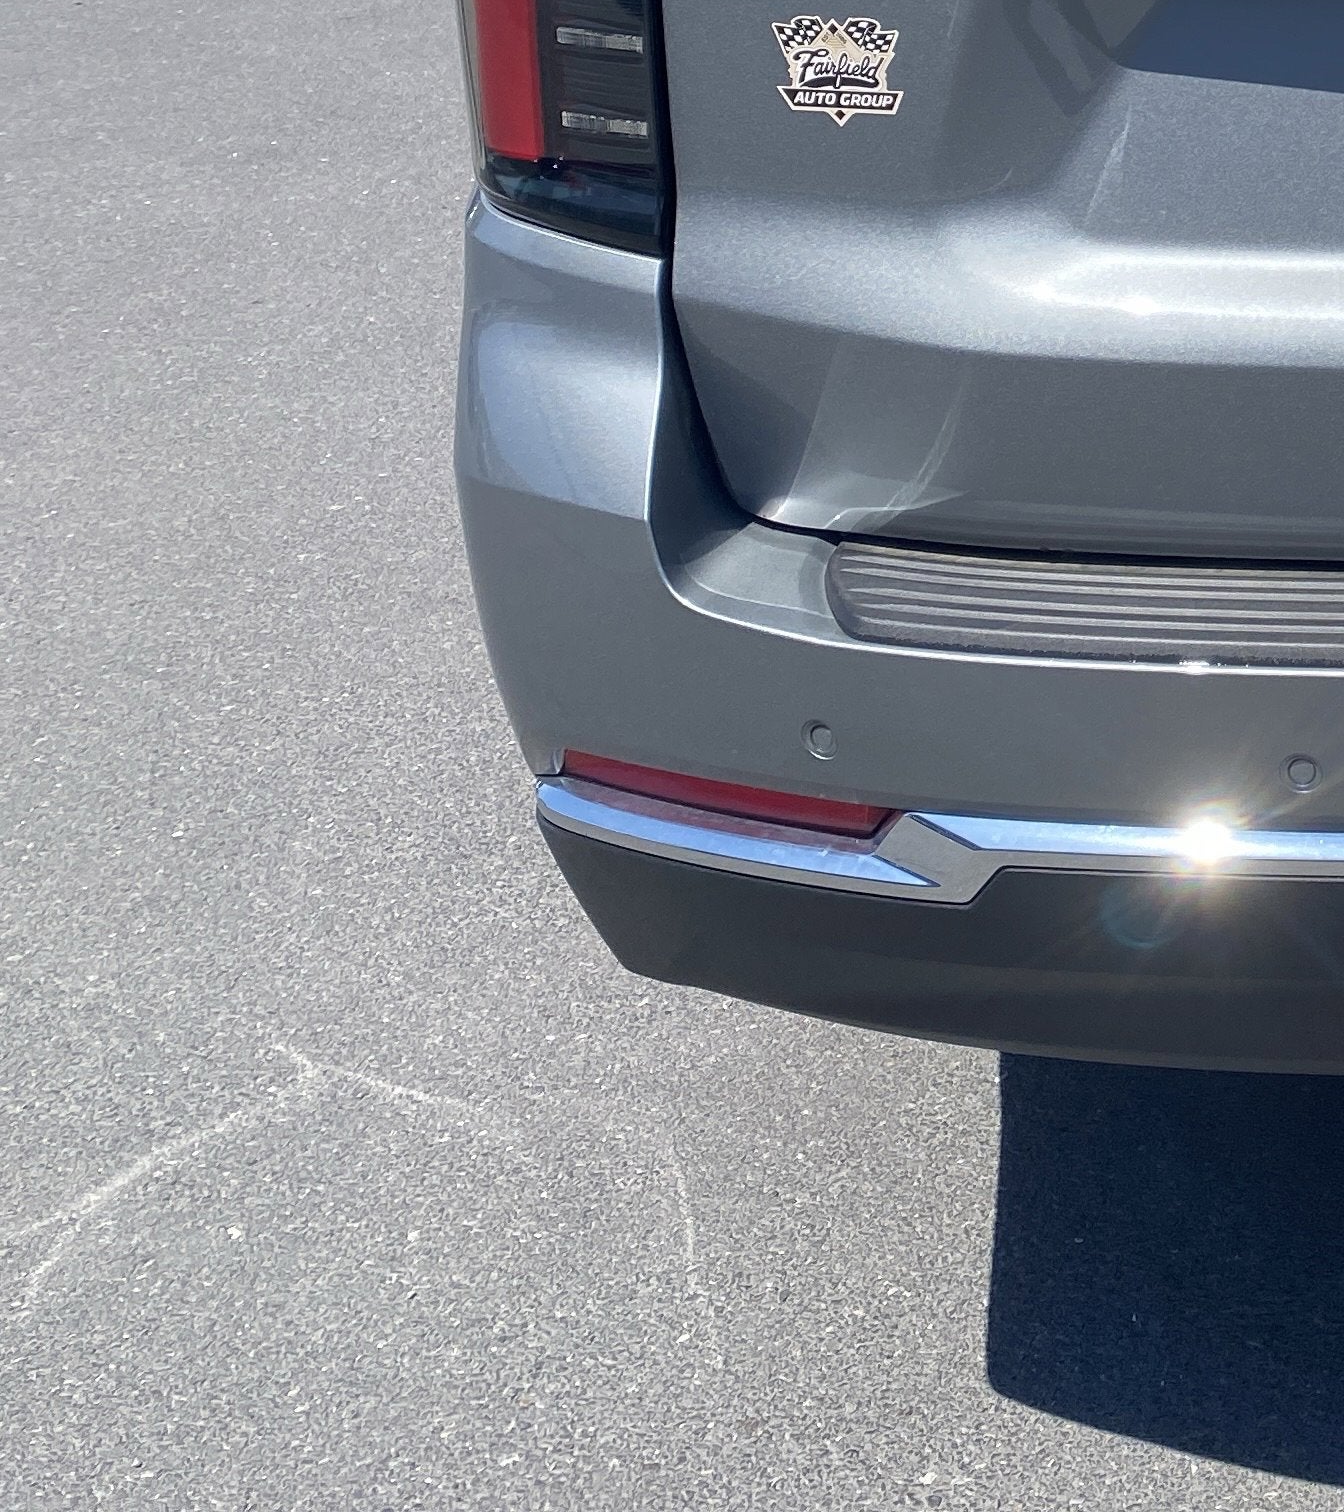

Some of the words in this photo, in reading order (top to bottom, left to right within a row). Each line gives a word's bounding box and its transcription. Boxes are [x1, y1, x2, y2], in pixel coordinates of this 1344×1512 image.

[792, 48, 884, 89] Fairfield
[793, 91, 837, 105] AUTO
[840, 93, 894, 107] GROUP
